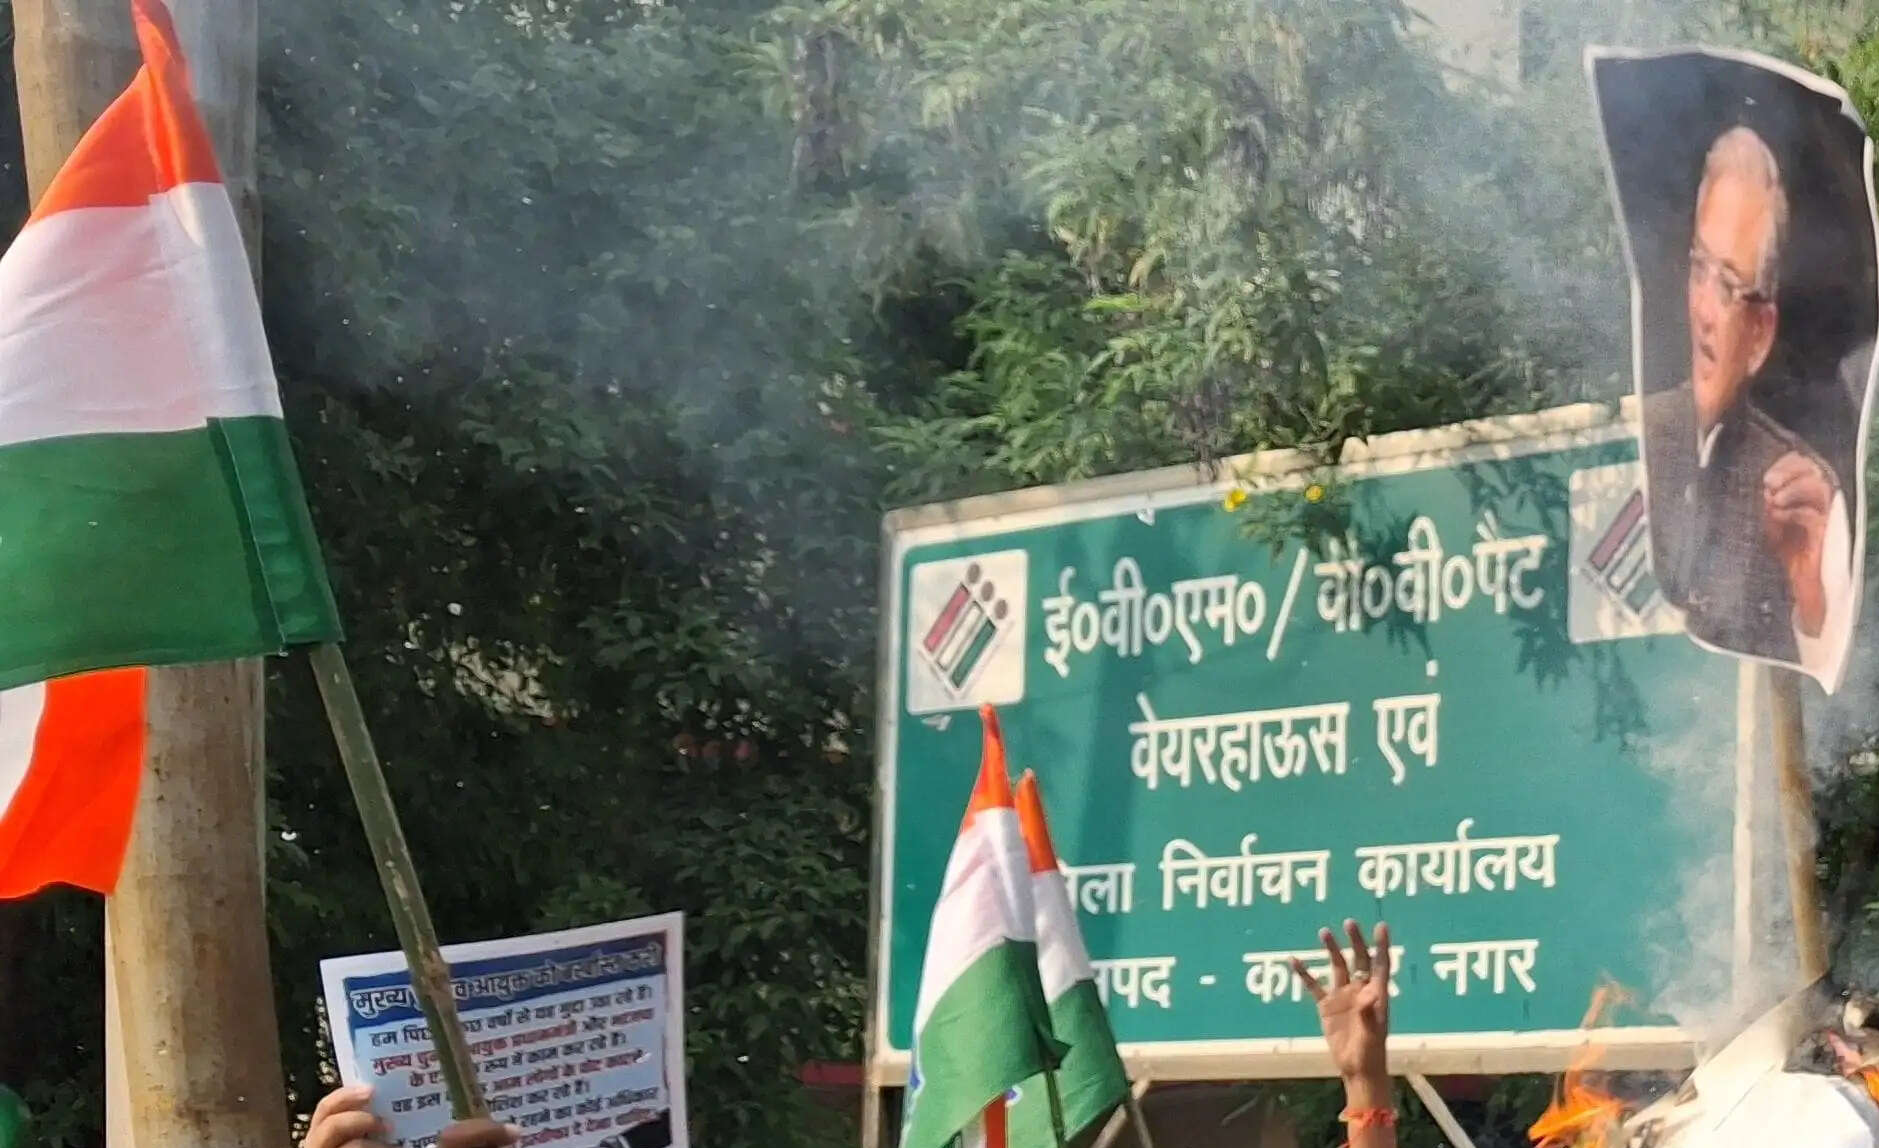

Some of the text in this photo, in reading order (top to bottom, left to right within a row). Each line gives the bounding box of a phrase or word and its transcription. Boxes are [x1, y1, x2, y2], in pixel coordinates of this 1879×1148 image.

[1128, 659, 1441, 791] वेयरहाऊस एवं
[1159, 833, 1331, 911] निर्वाचन
[1355, 818, 1560, 898] कार्यालय
[1430, 939, 1539, 996] नगर
